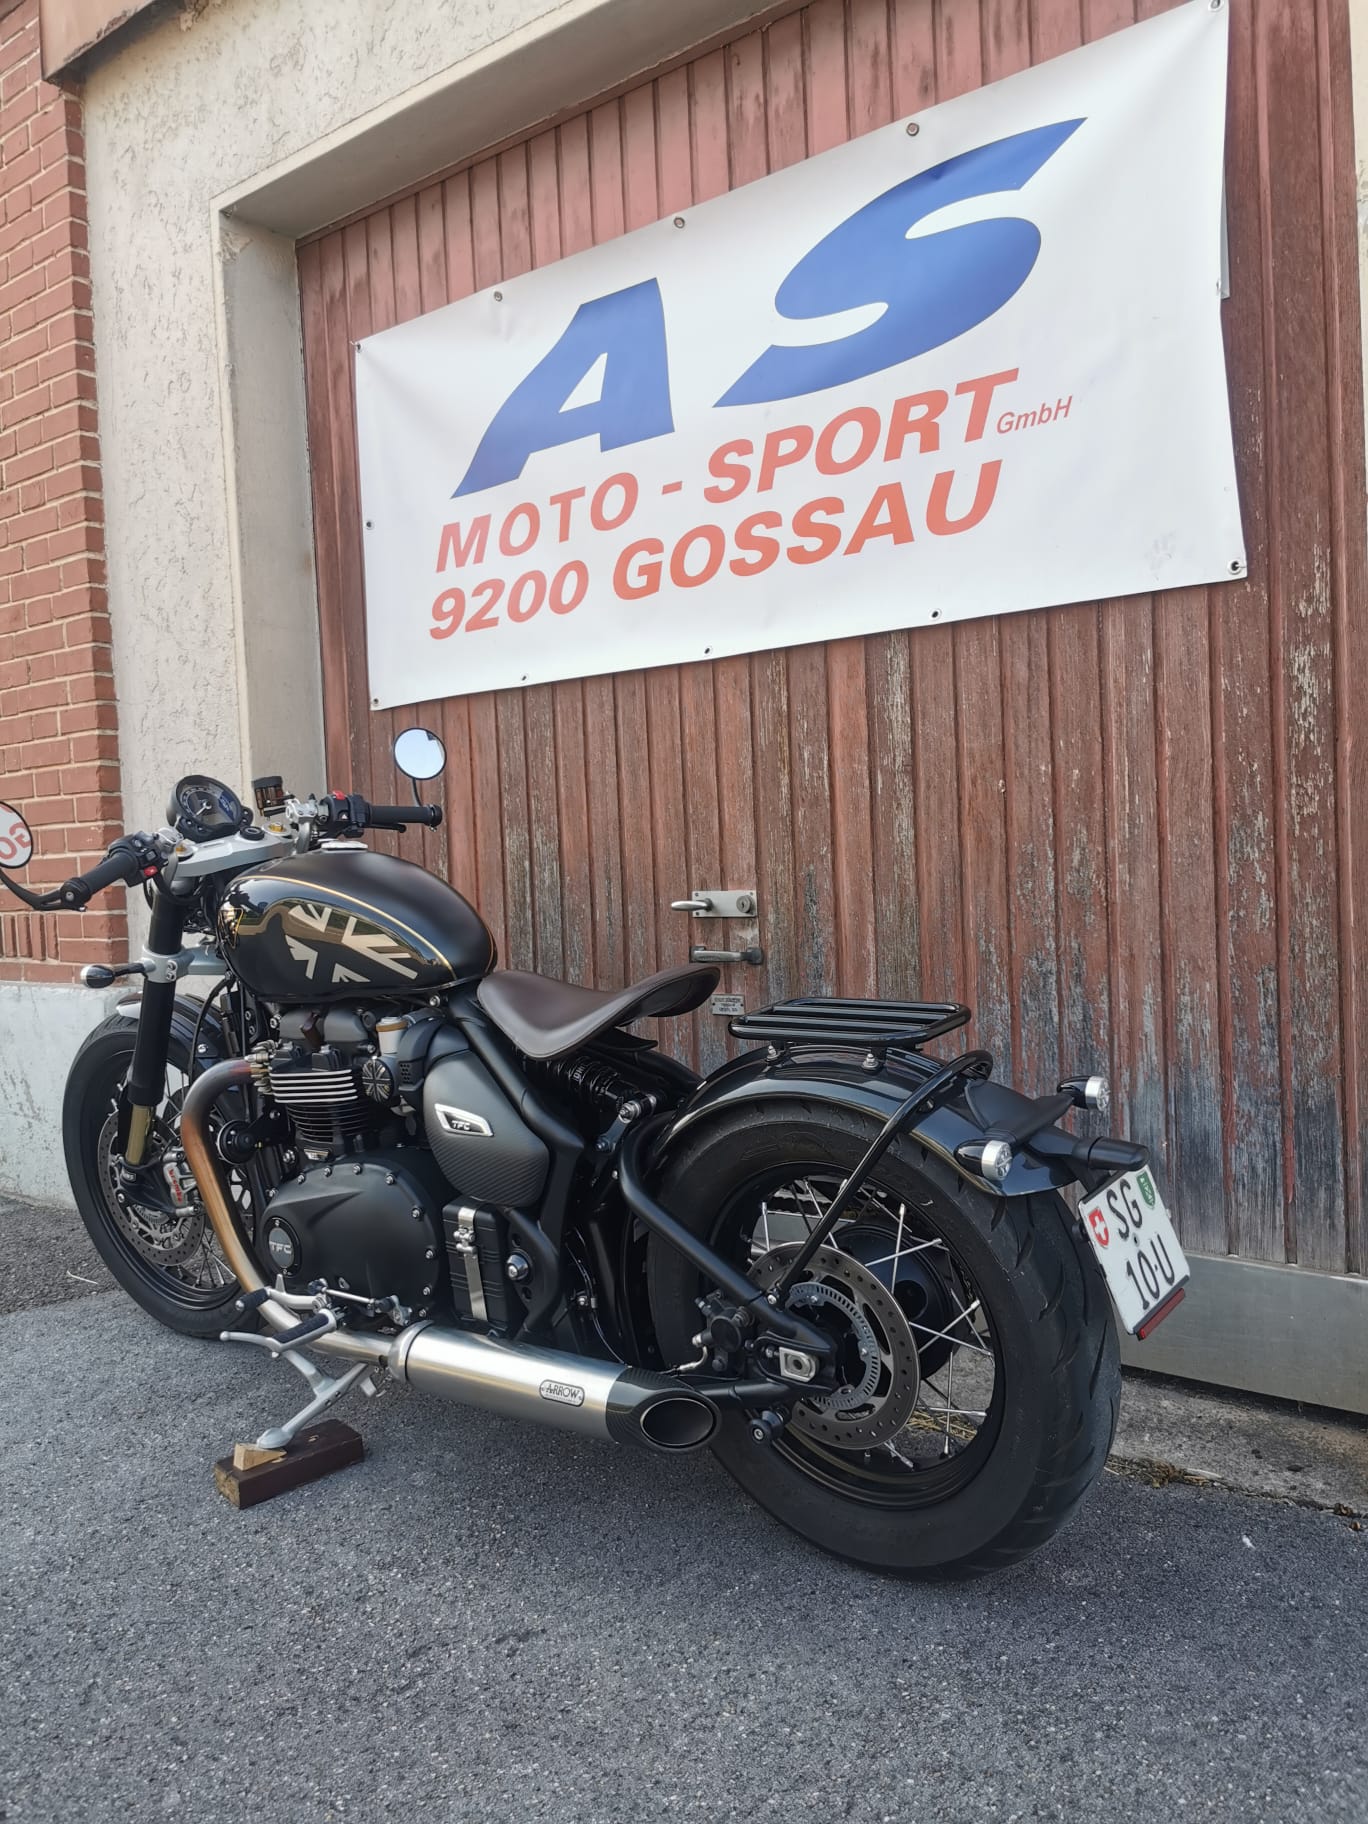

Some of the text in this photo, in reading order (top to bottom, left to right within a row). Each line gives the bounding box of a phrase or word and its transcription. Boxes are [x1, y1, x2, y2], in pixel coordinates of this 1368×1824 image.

[436, 472, 639, 572] MOTO
[703, 368, 1019, 504] SPORT
[995, 395, 1073, 435] GmbH
[429, 460, 1002, 640] 9200 GOSSAU
[1106, 1178, 1143, 1241] SG
[545, 1383, 580, 1399] ARROW
